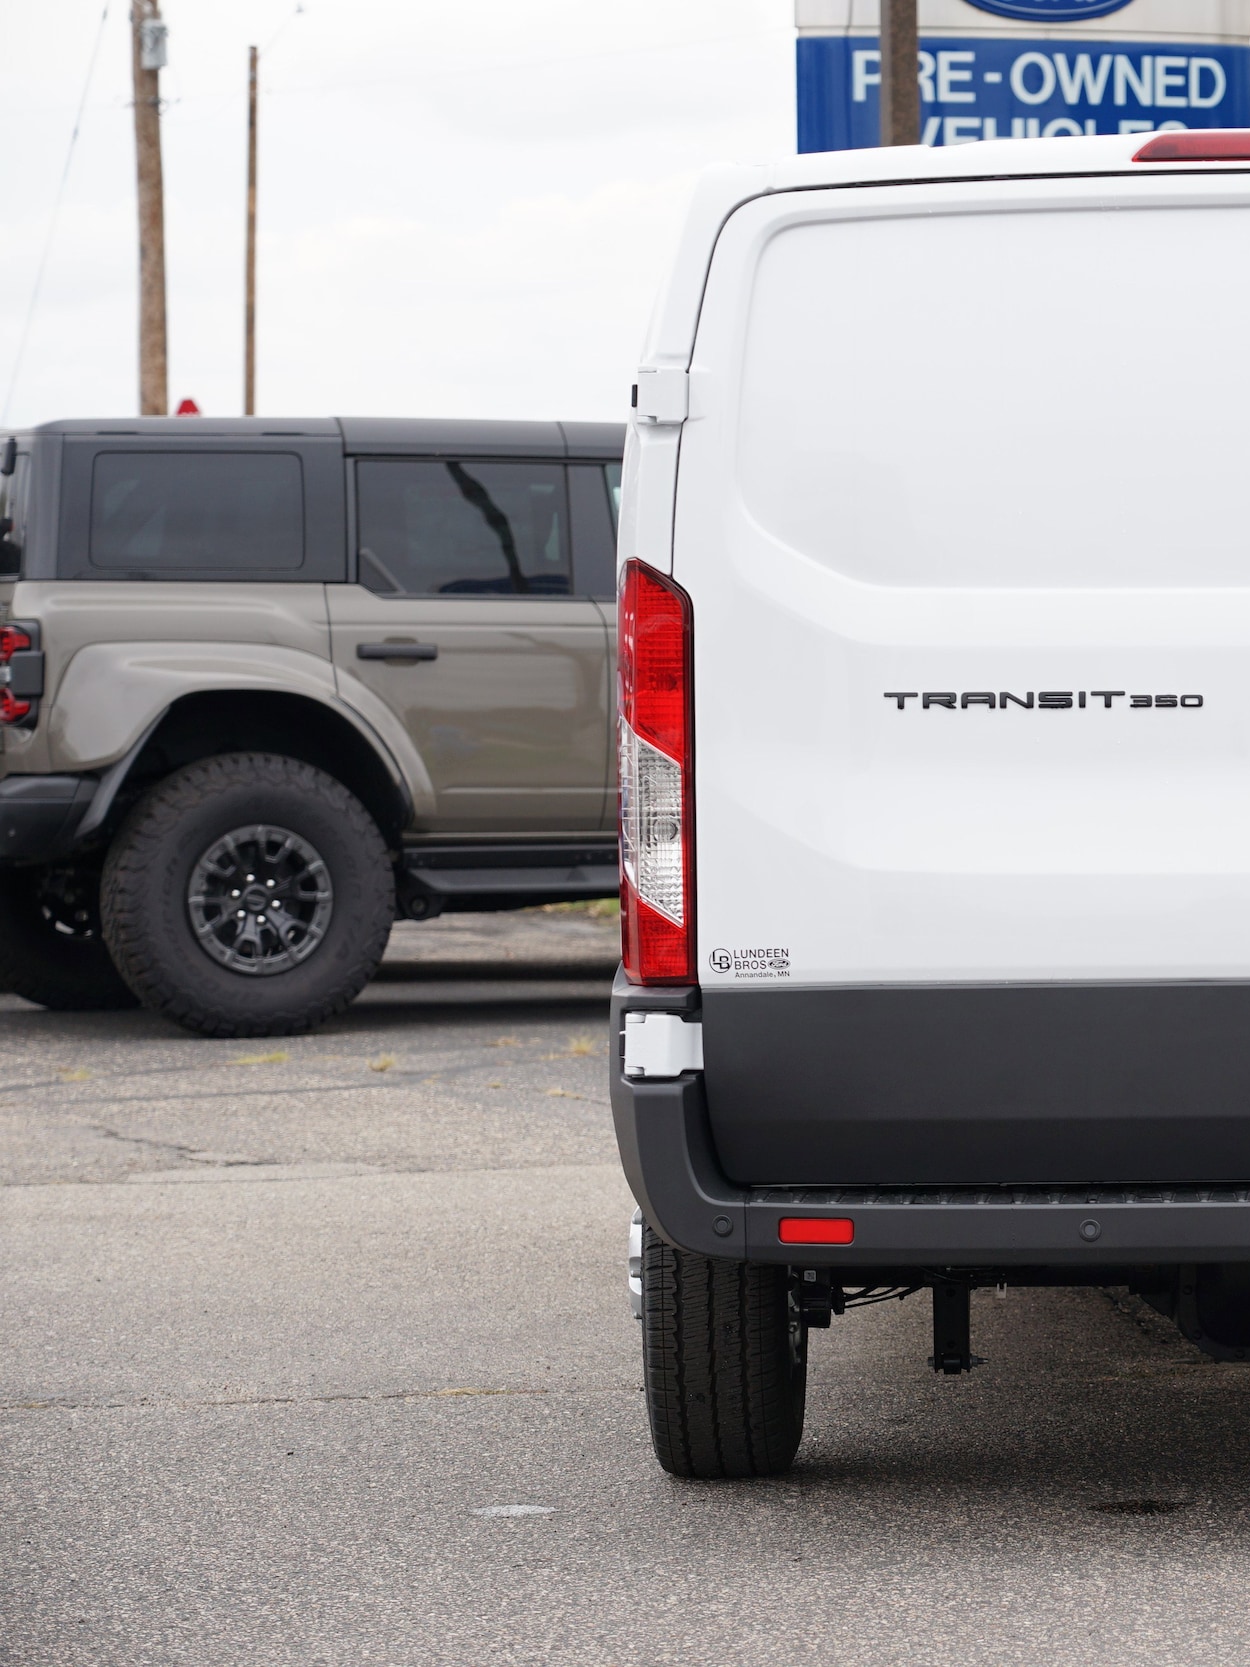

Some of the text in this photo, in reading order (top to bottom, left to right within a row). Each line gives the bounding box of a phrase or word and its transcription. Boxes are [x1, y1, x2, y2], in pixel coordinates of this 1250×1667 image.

[883, 690, 1204, 710] TRANSIT 350
[733, 948, 789, 959] LUNDEEN
[734, 960, 767, 970] BROS
